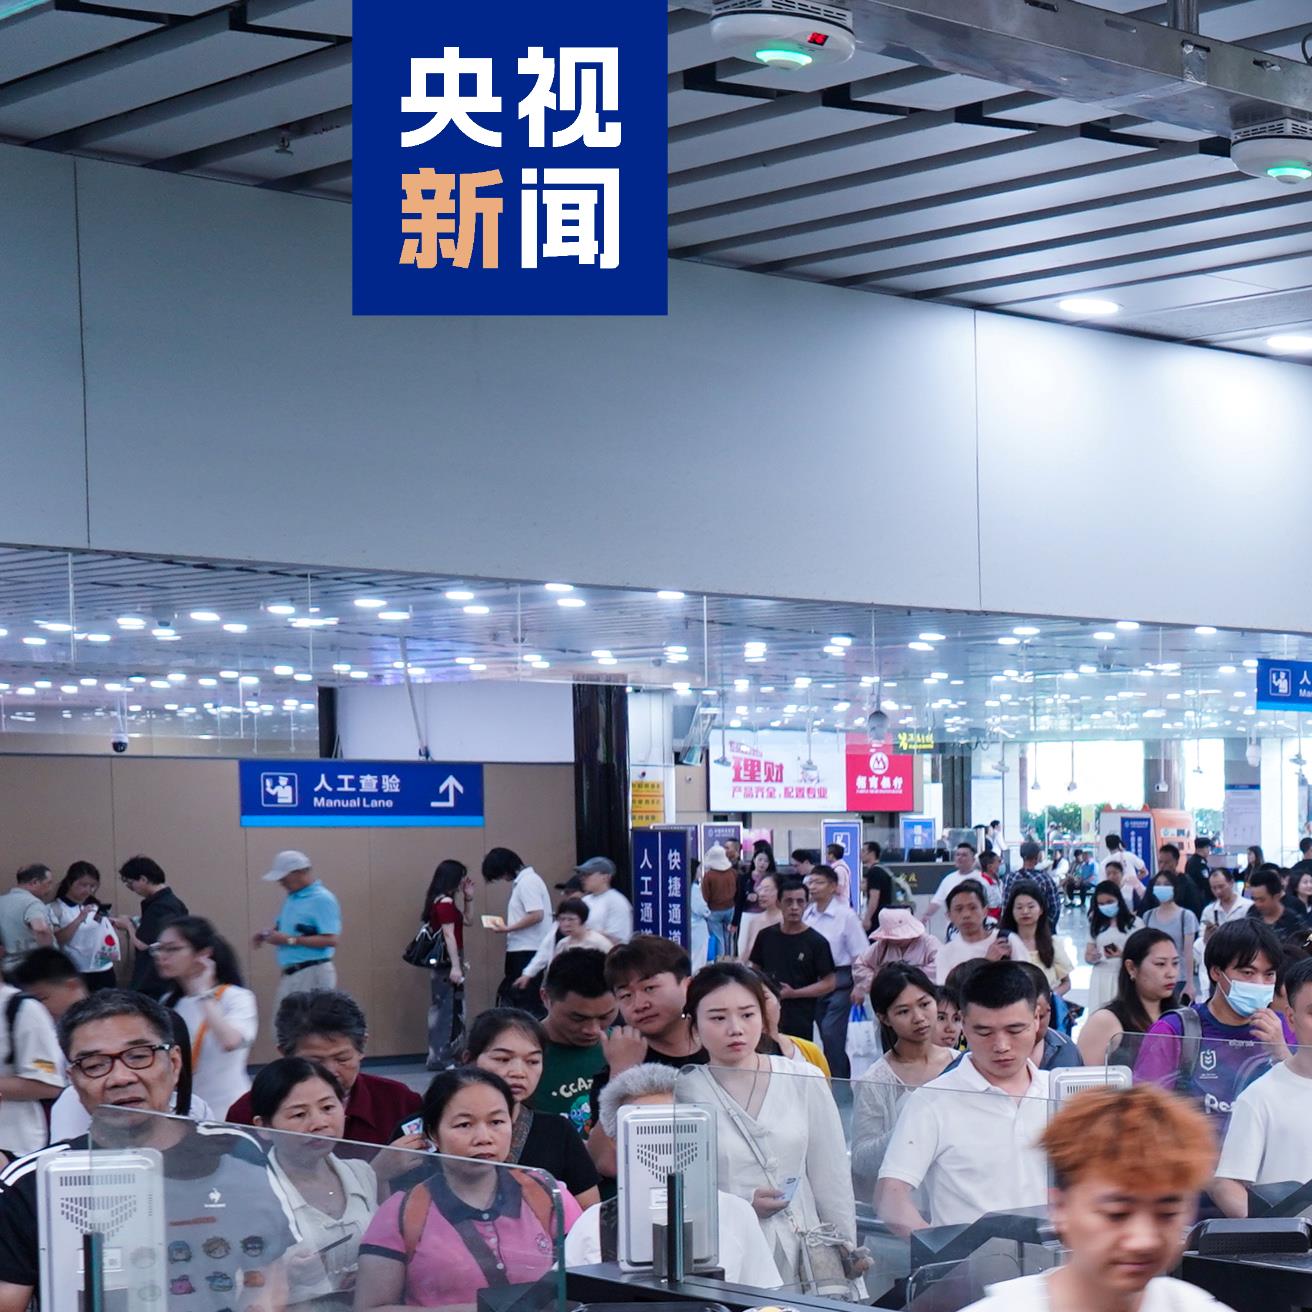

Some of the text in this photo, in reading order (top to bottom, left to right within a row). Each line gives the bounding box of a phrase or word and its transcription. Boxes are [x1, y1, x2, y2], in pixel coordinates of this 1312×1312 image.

[732, 756, 784, 783] 理财
[314, 774, 400, 793] 人工查验
[314, 797, 393, 808] Manual Lane
[668, 848, 681, 948] 快捷通道
